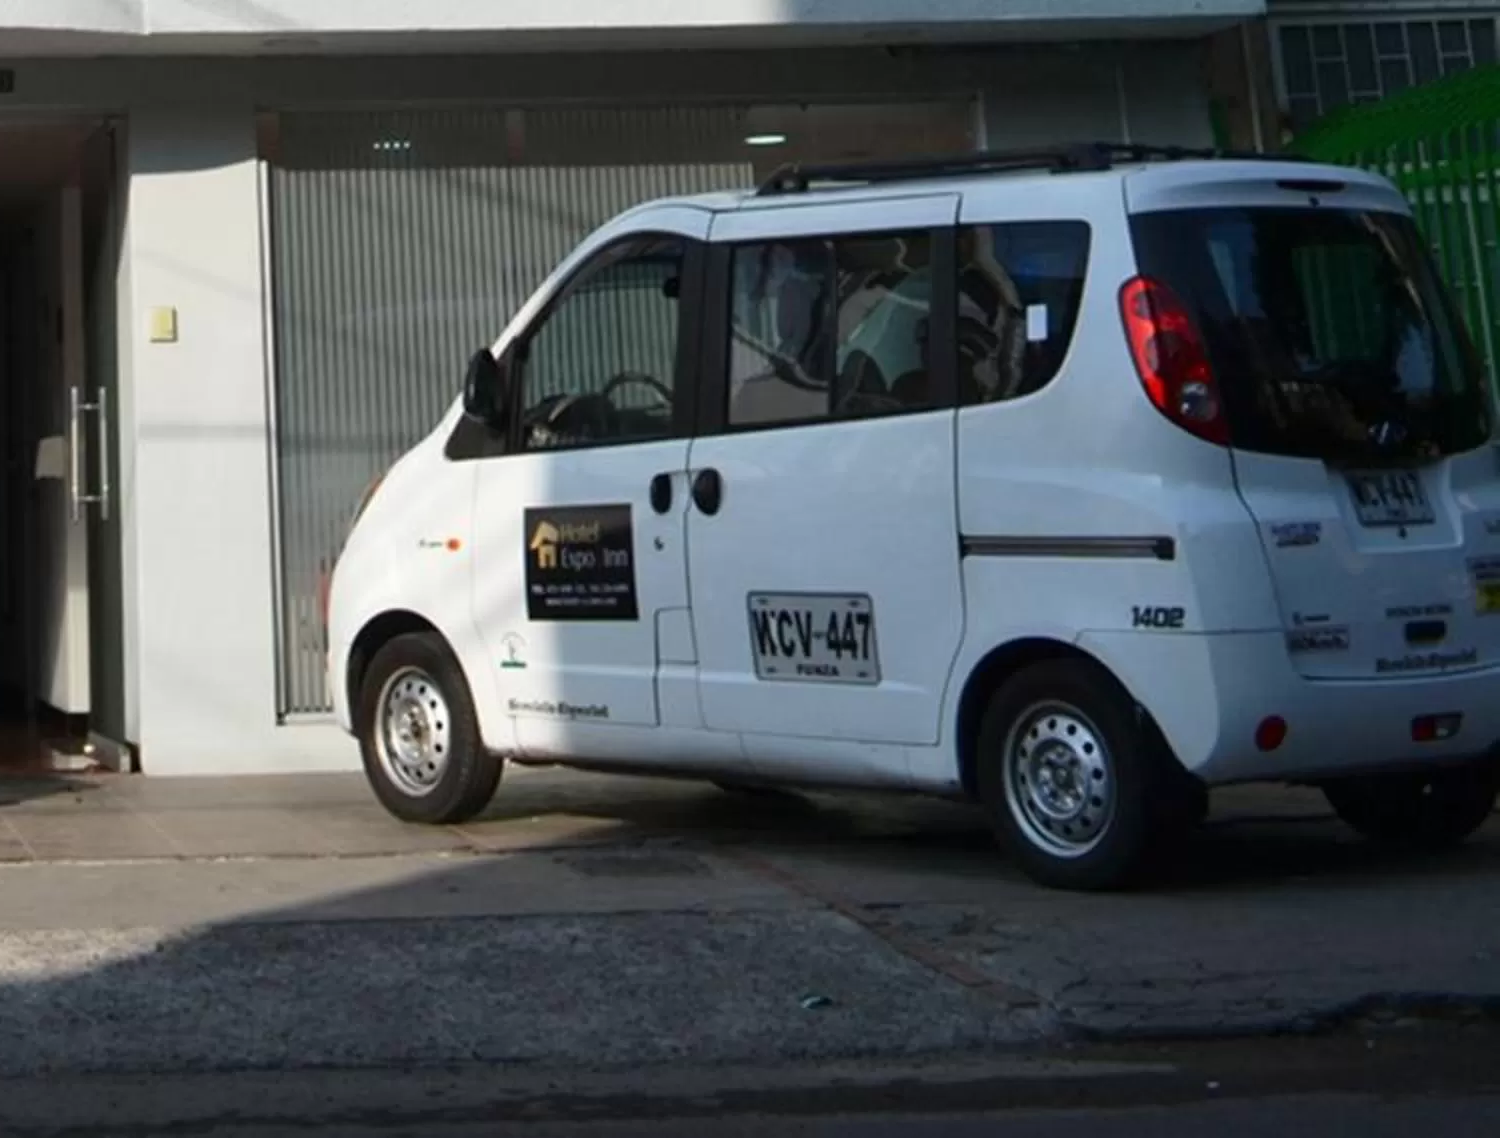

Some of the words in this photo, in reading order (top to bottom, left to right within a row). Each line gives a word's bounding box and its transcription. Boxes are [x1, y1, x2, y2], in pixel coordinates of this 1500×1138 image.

[560, 520, 600, 543] Hotel
[561, 547, 596, 572] Expo
[603, 547, 630, 568] Inn
[1131, 605, 1186, 629] 1402
